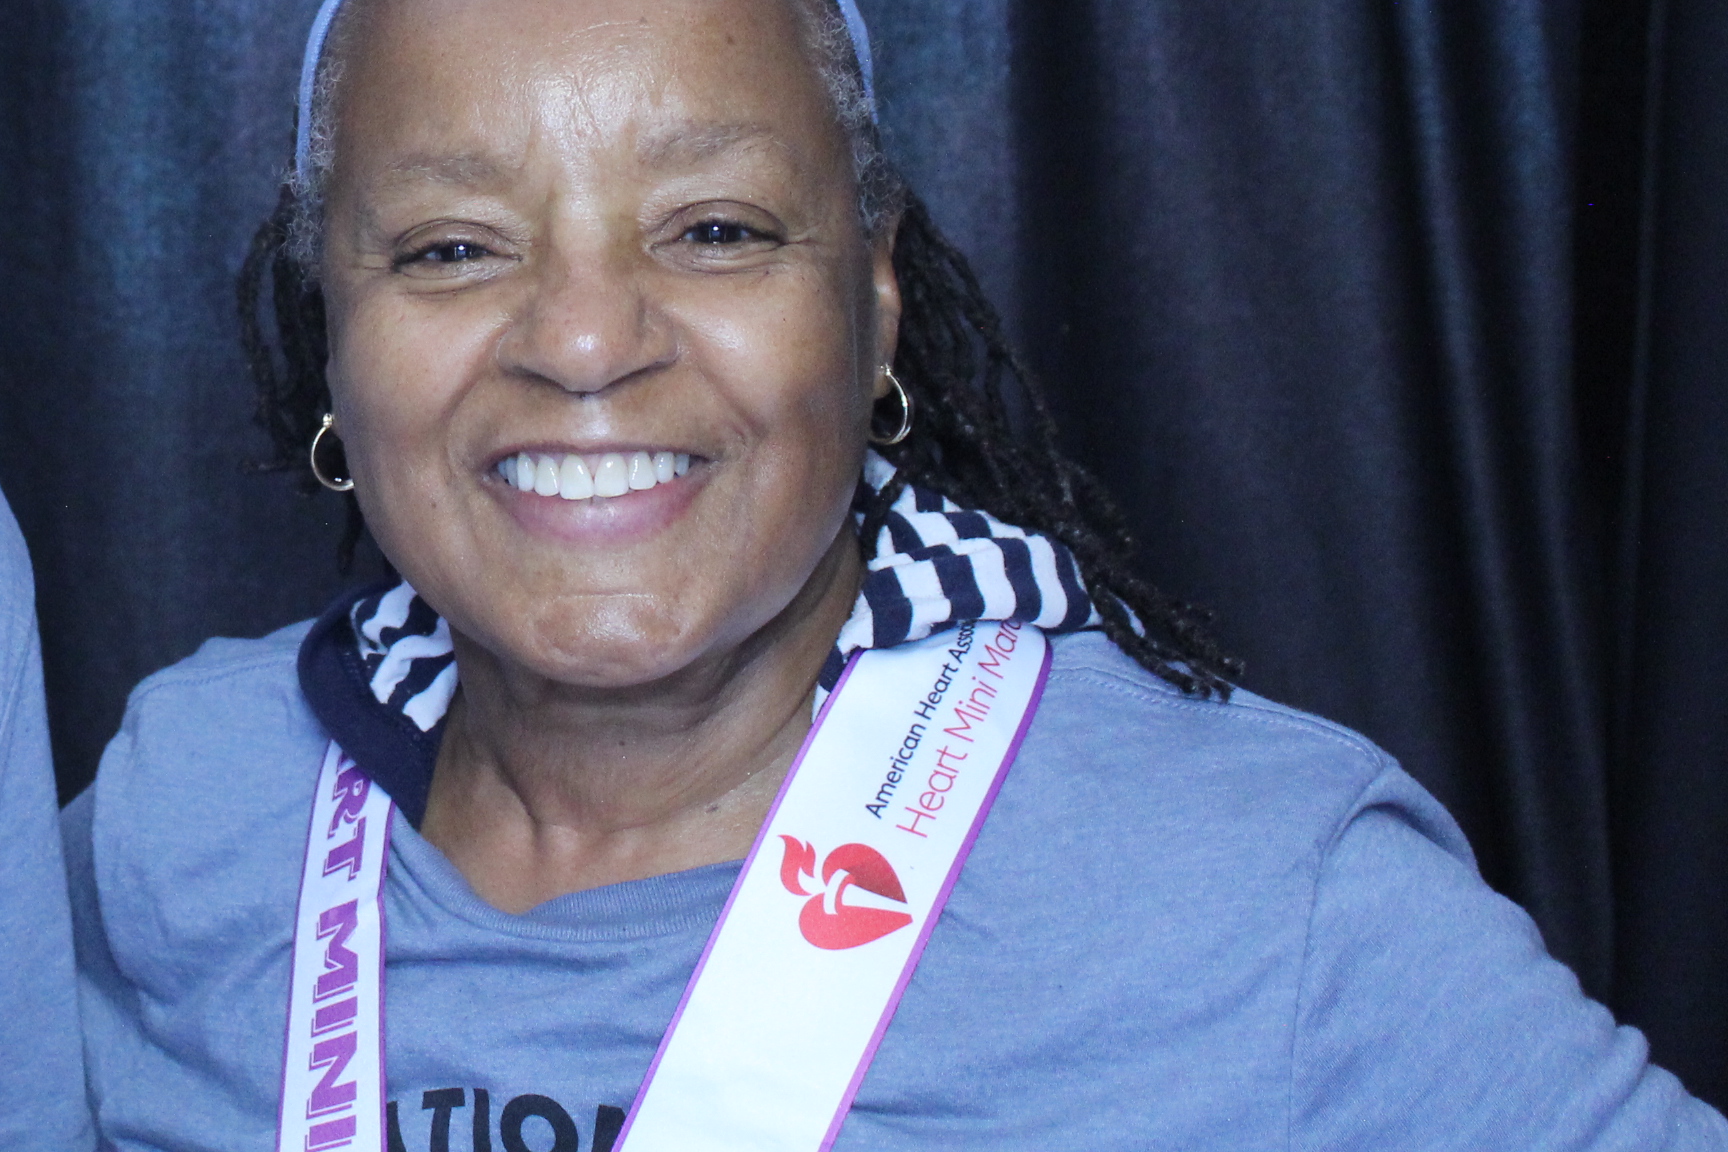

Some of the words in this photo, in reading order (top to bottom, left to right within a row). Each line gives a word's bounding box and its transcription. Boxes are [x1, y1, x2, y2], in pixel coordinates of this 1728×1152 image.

[865, 722, 926, 820] American
[914, 662, 959, 721] Heart
[895, 745, 969, 838] Heart
[943, 675, 998, 743] Mini
[305, 898, 359, 1152] MINI
